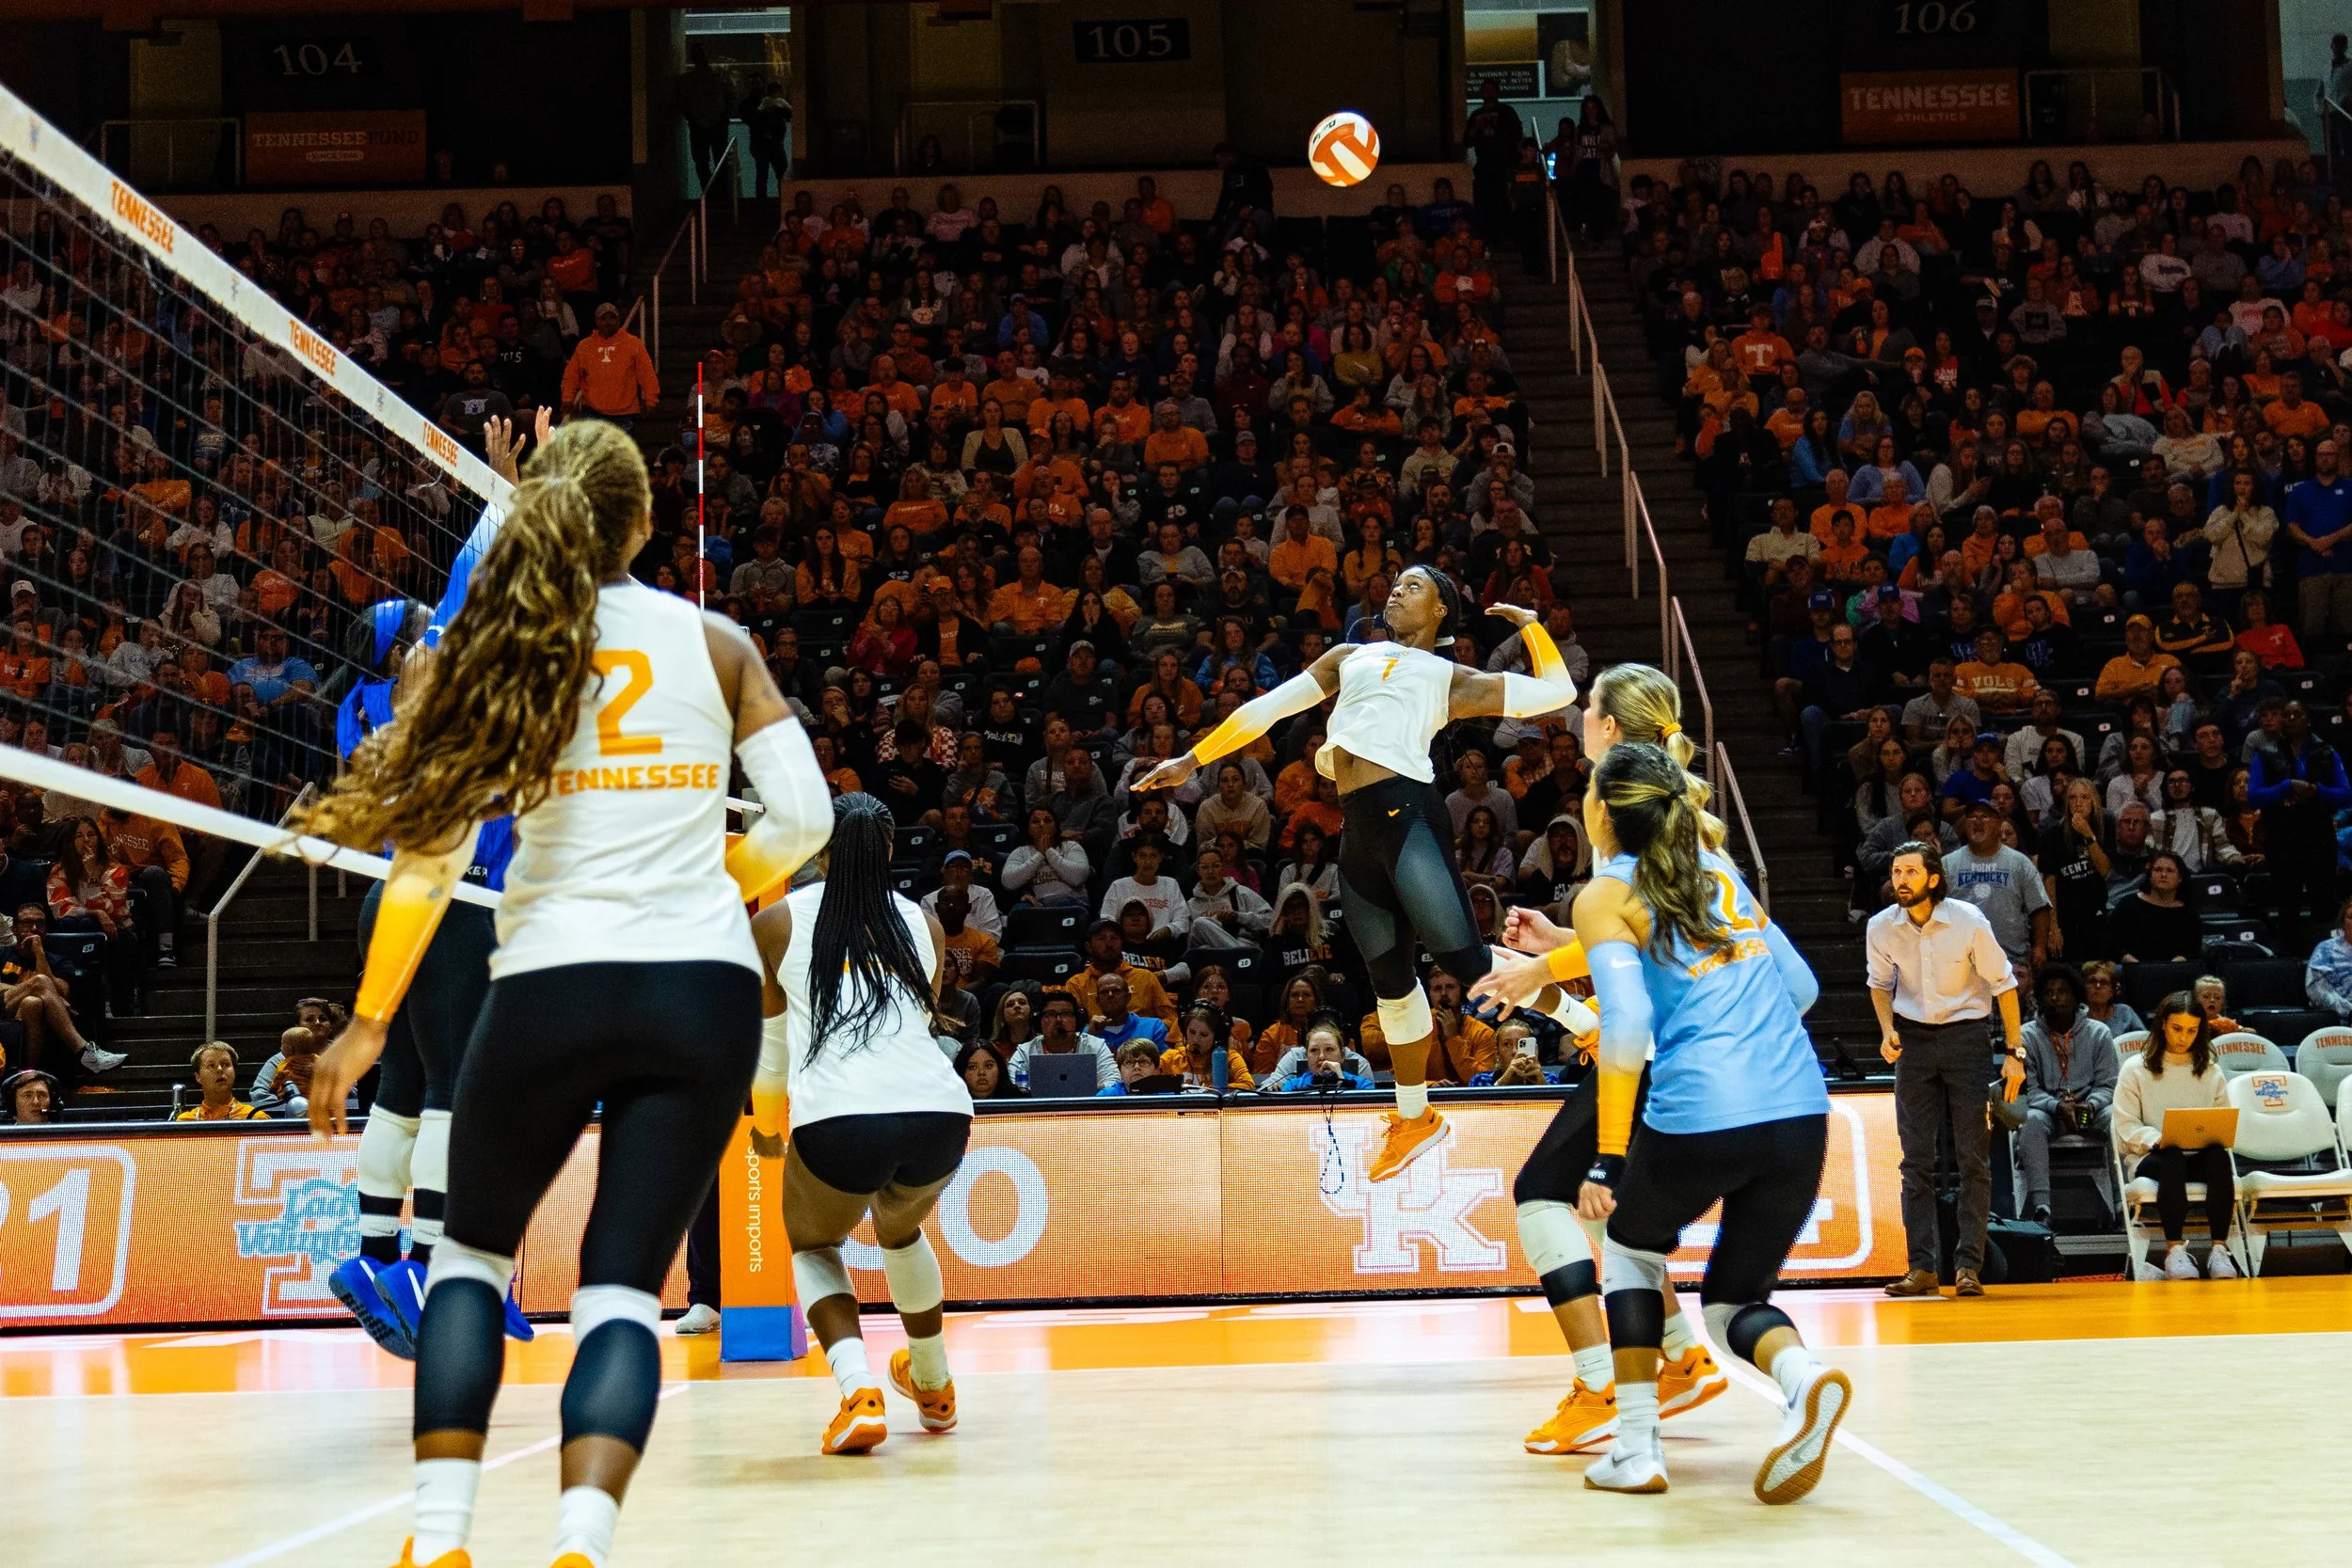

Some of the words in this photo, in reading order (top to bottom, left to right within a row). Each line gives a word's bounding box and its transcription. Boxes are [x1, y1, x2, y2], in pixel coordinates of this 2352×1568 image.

[1895, 0, 1977, 34] 106
[1088, 24, 1172, 58] 105
[273, 41, 363, 76] 104
[1850, 83, 2010, 111] TENNESSEE
[253, 132, 367, 147] TENNESSEE
[369, 131, 420, 145] FUND
[111, 182, 174, 254] TENNESSEE
[289, 320, 337, 377] TENNESSEE
[597, 345, 616, 363] T
[1745, 344, 1773, 367] T
[422, 420, 459, 467] TENNESSEE
[1382, 657, 1398, 682] 7
[1971, 674, 2015, 689] VOLS
[592, 648, 662, 757] 2
[557, 763, 721, 798] ENNESSEE
[1958, 871, 2010, 887] KENTUCKY
[1283, 944, 1333, 967] BELIEVE
[2216, 1040, 2266, 1055] TENNESSEE
[745, 1146, 763, 1201] sports
[0, 1167, 90, 1292] 1
[746, 1205, 763, 1273] imports
